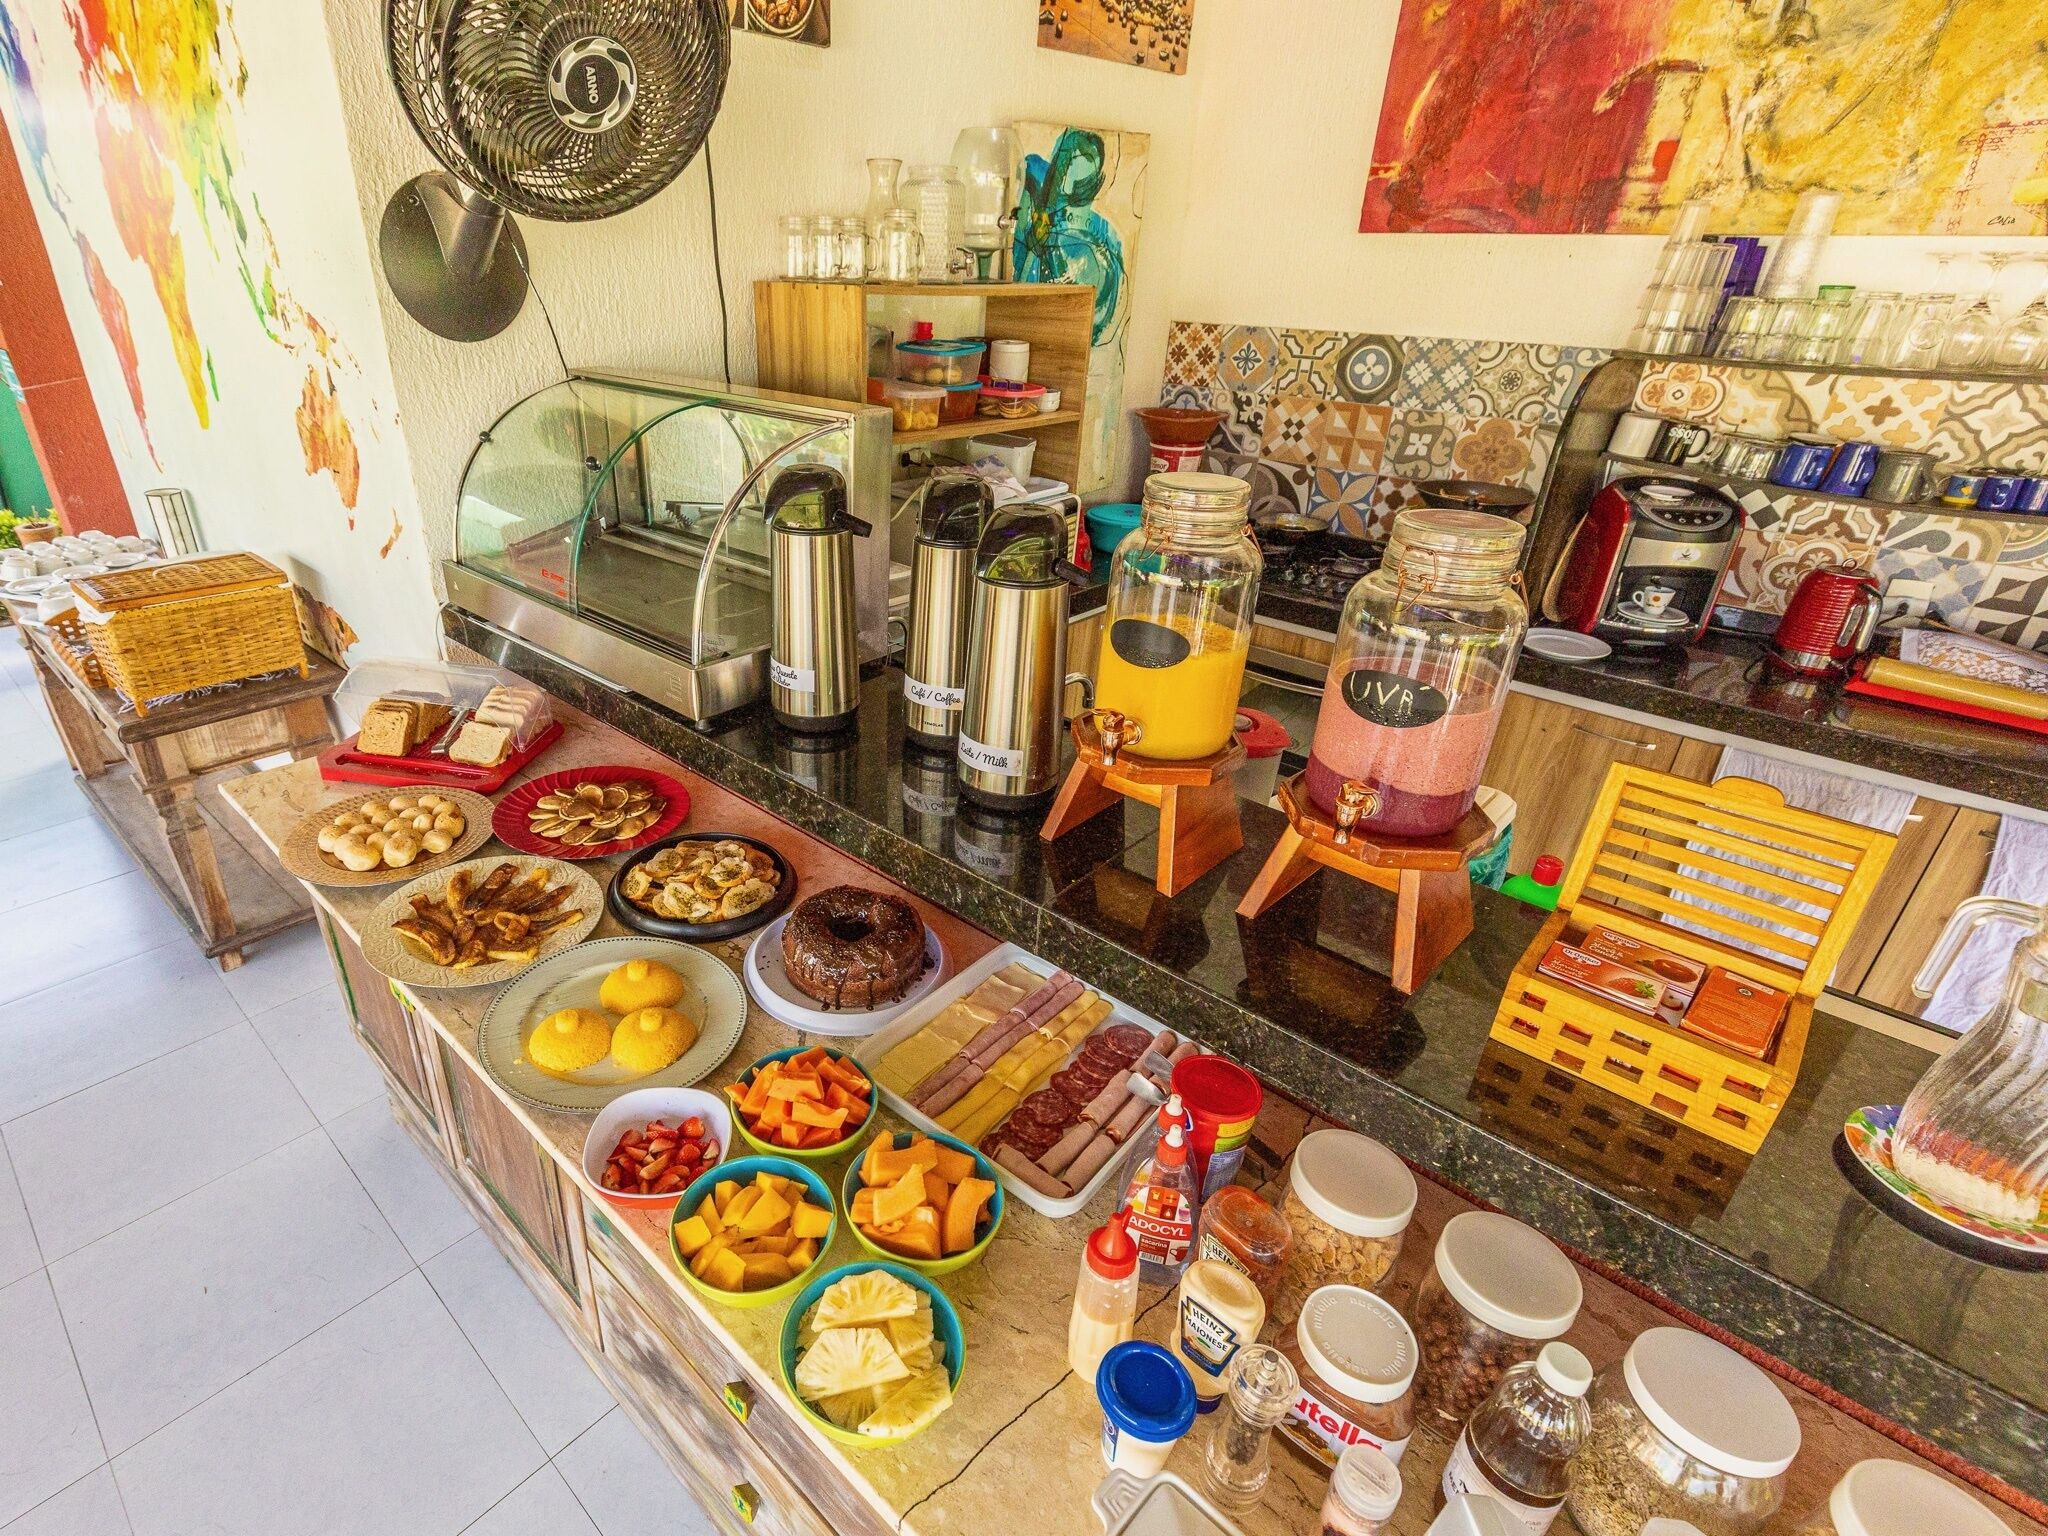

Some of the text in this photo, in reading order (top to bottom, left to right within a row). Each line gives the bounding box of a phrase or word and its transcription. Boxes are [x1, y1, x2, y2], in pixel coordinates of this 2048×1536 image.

[585, 66, 599, 104] ARNO
[911, 685, 926, 700] Café
[934, 692, 961, 705] Coffee
[1350, 671, 1414, 716] UVA
[982, 753, 1008, 768] Milk
[1129, 1215, 1187, 1237] ADOCYL
[1141, 1238, 1168, 1248] sacarina
[1185, 1315, 1228, 1352] MAIONESE
[1192, 1307, 1225, 1337] HEINZ
